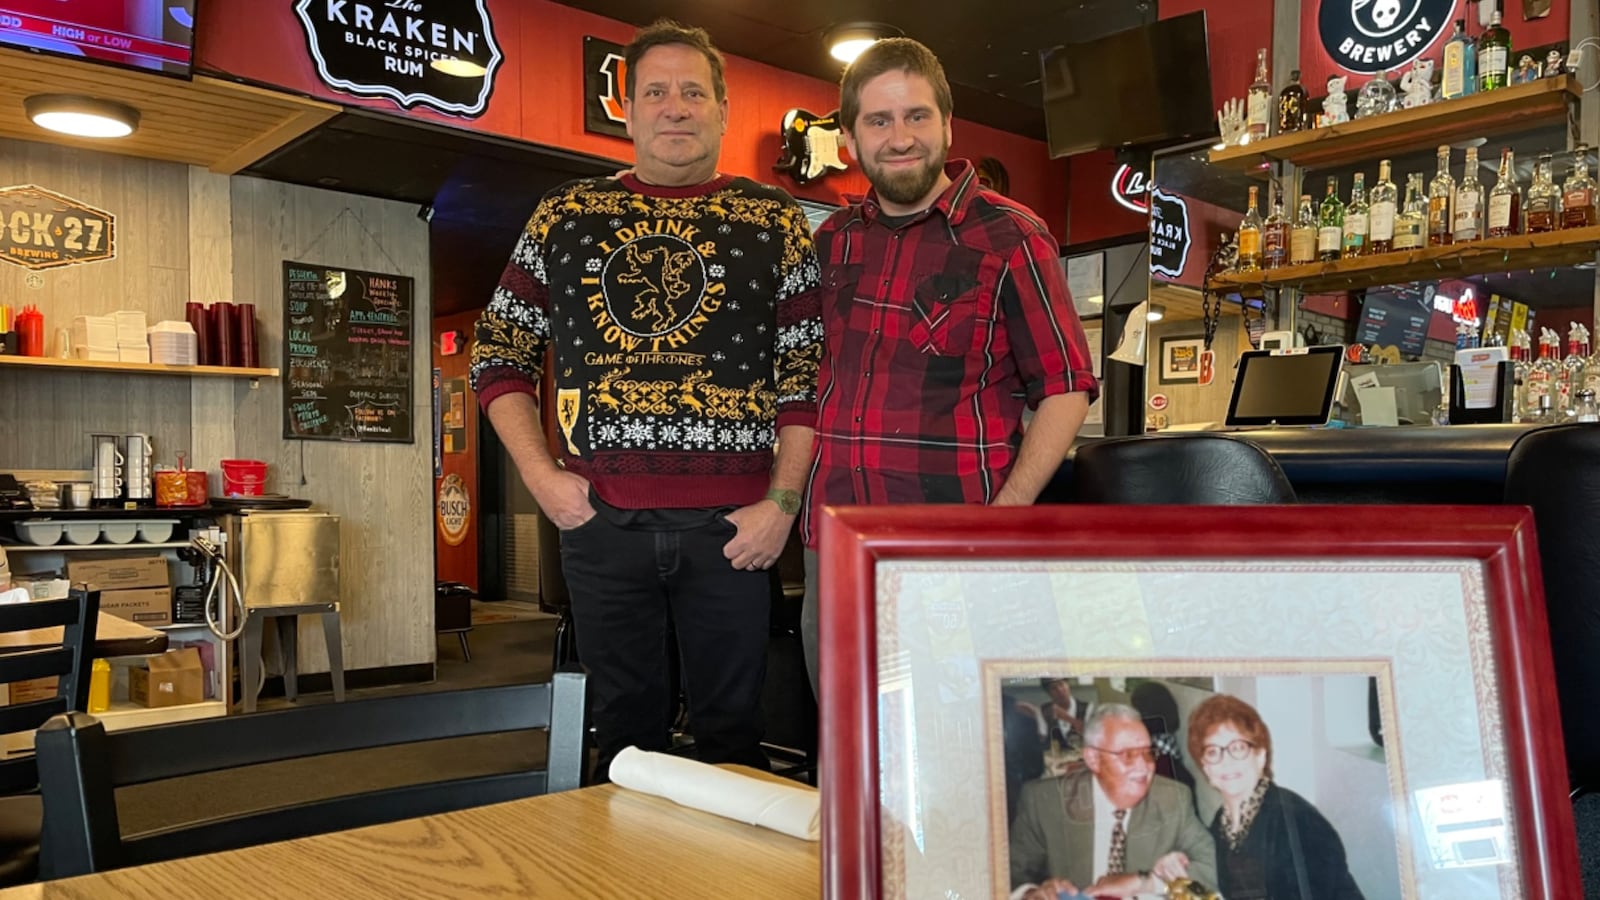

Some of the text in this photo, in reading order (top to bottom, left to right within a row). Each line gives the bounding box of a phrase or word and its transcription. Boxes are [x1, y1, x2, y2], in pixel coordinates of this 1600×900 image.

[0, 15, 133, 49] DD HIGH or LOW
[327, 0, 475, 55] KRAKEN
[1338, 16, 1432, 63] BREWERY
[344, 31, 398, 54] BLACK
[384, 56, 424, 78] RUM
[0, 209, 103, 252] CK 27
[597, 218, 717, 258] I DRINK &
[10, 246, 59, 259] BREWING
[580, 276, 727, 353] I KNOW THINGS
[288, 329, 312, 342] LOCAL
[584, 352, 626, 366] GAME
[634, 351, 706, 366] THRONES
[440, 500, 469, 518] BUSCH
